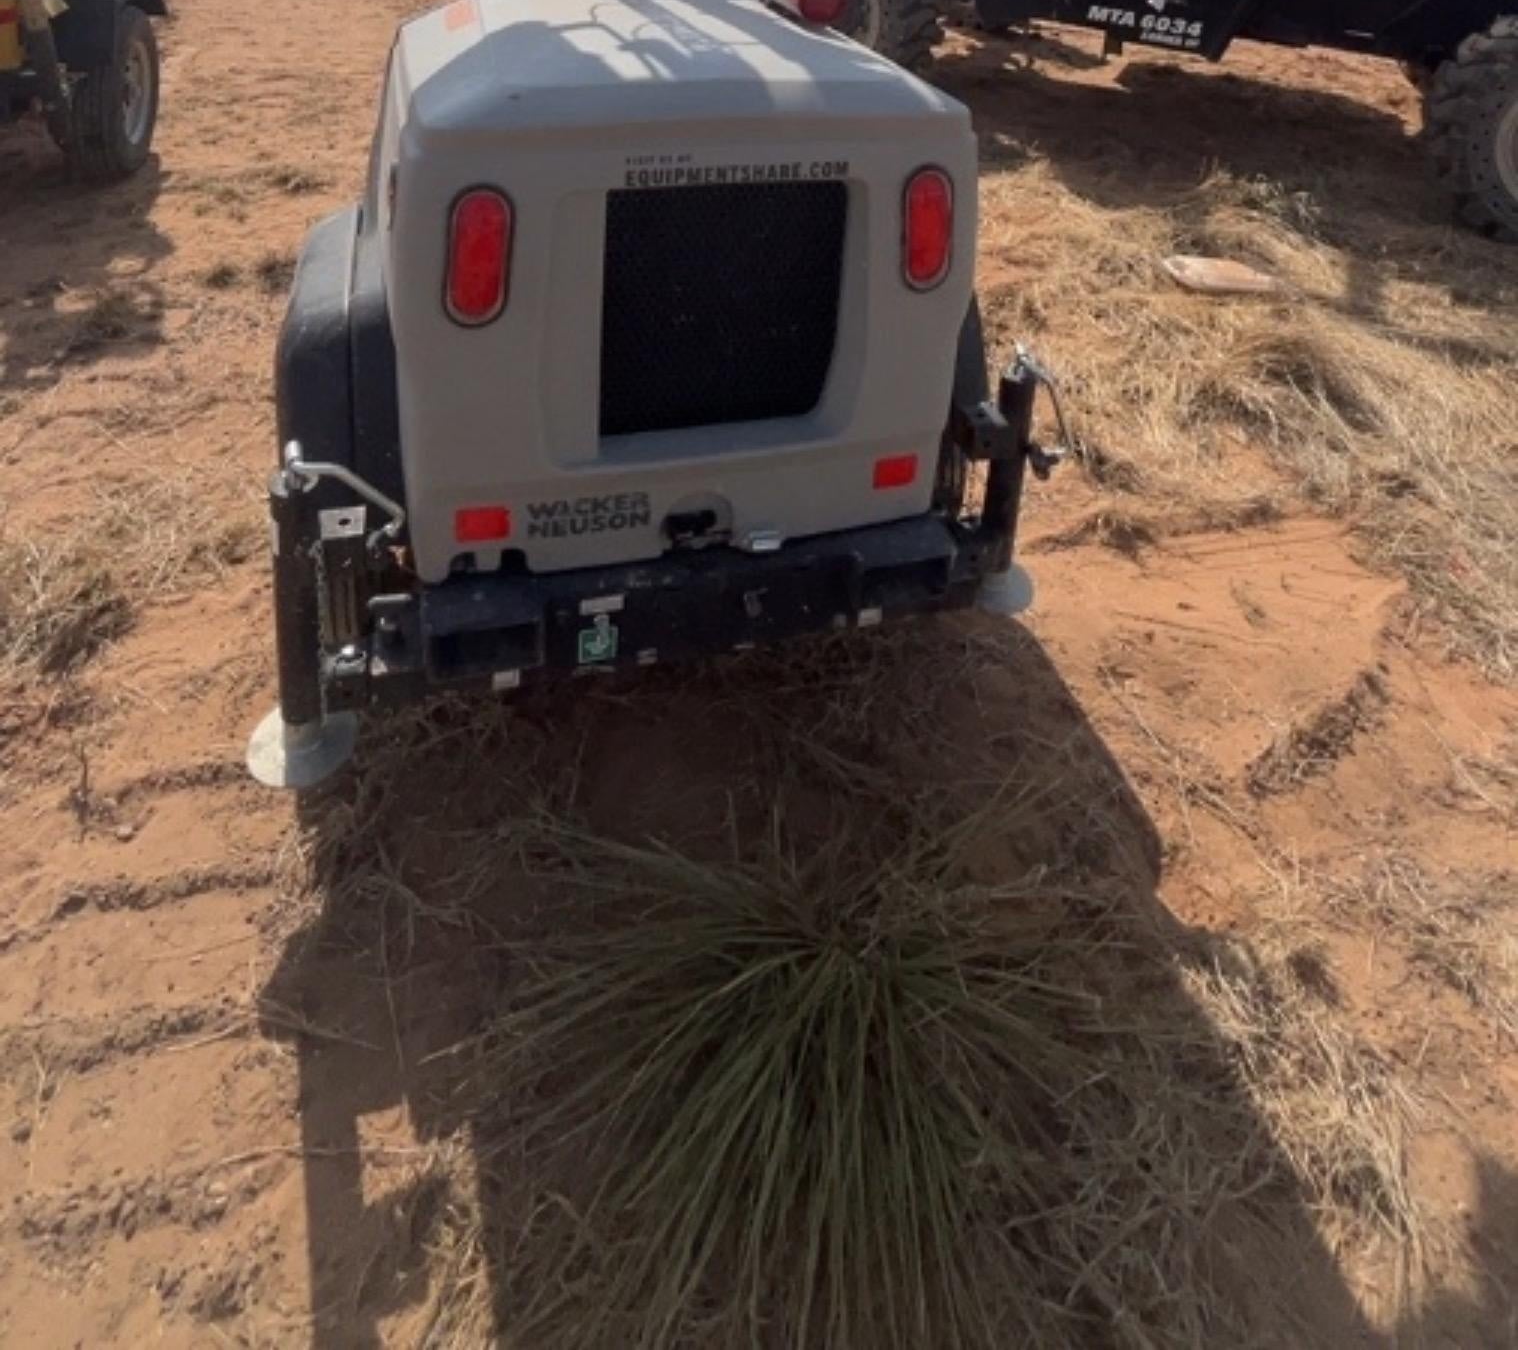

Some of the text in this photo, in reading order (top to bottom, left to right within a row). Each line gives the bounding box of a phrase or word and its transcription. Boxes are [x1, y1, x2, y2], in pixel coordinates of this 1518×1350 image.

[1088, 5, 1203, 36] MTA 6034
[625, 161, 849, 187] EQUIPMENTSHARE.COM
[527, 492, 649, 520] WACKER
[527, 510, 651, 539] NEUSON
